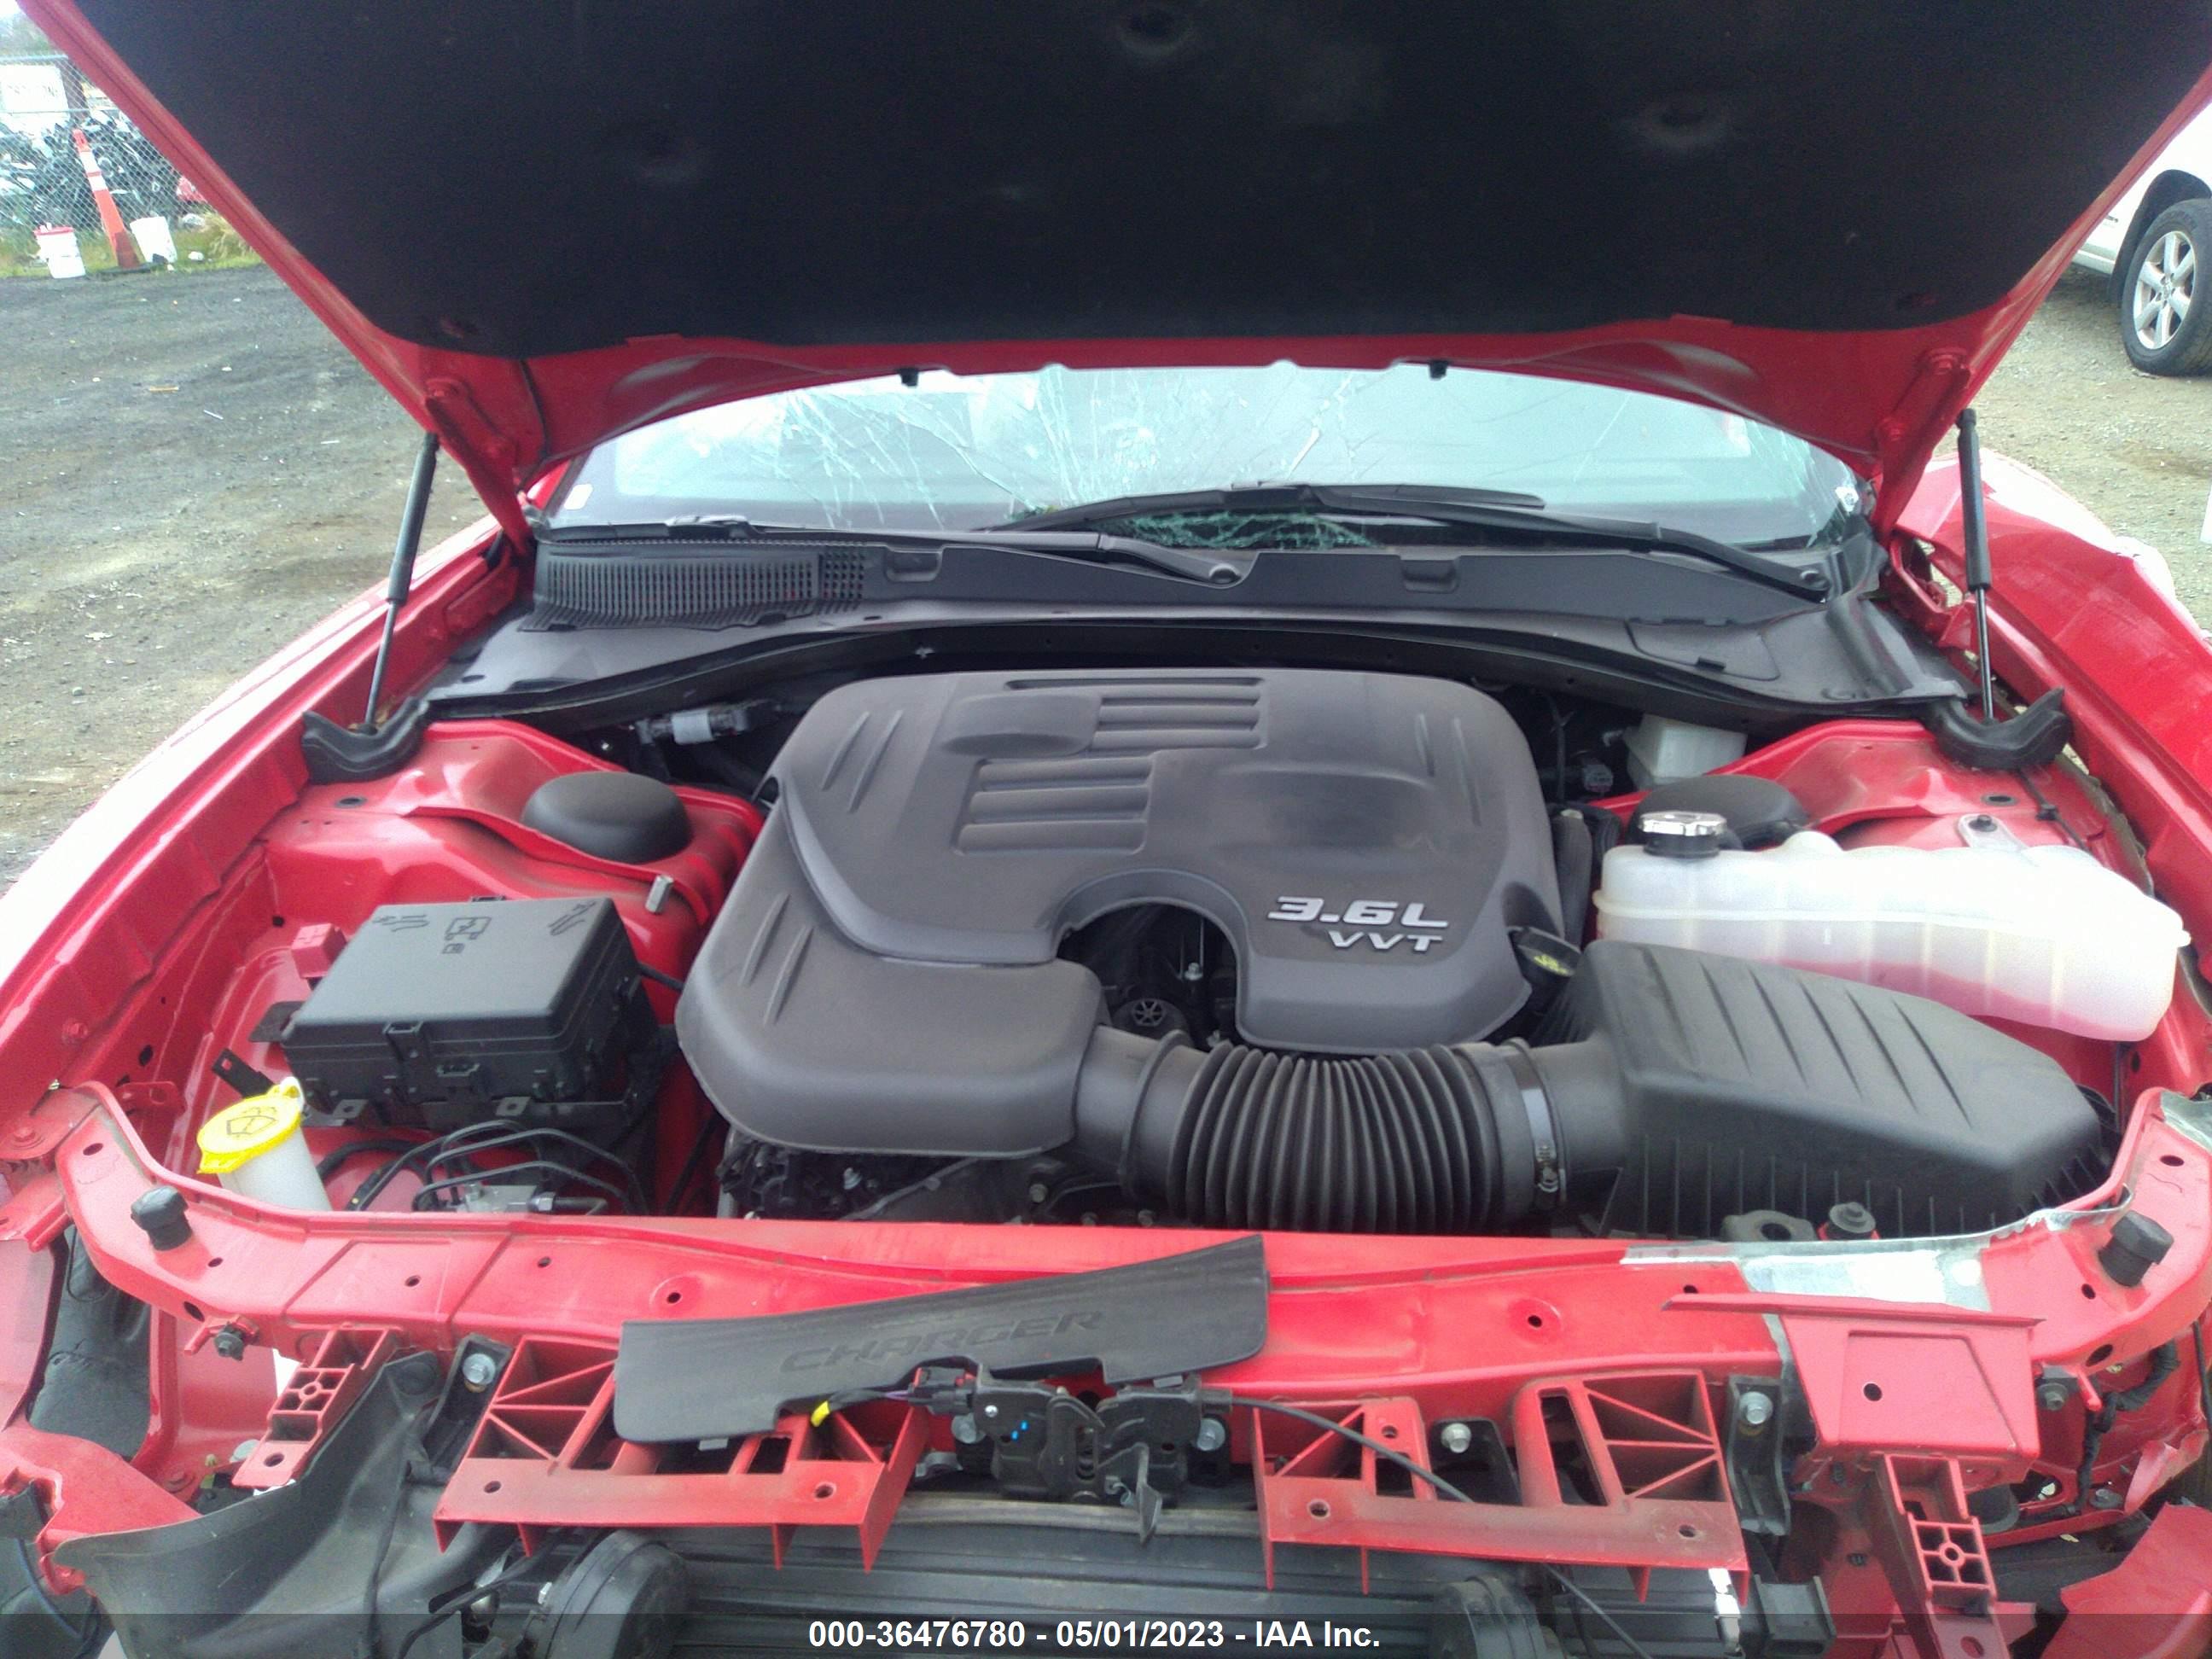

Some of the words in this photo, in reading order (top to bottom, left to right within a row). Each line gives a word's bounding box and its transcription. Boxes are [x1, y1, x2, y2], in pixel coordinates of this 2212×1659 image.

[1267, 895, 1449, 928] 3.6L
[1328, 929, 1443, 952] VVT
[781, 1311, 1103, 1372] CHARGER
